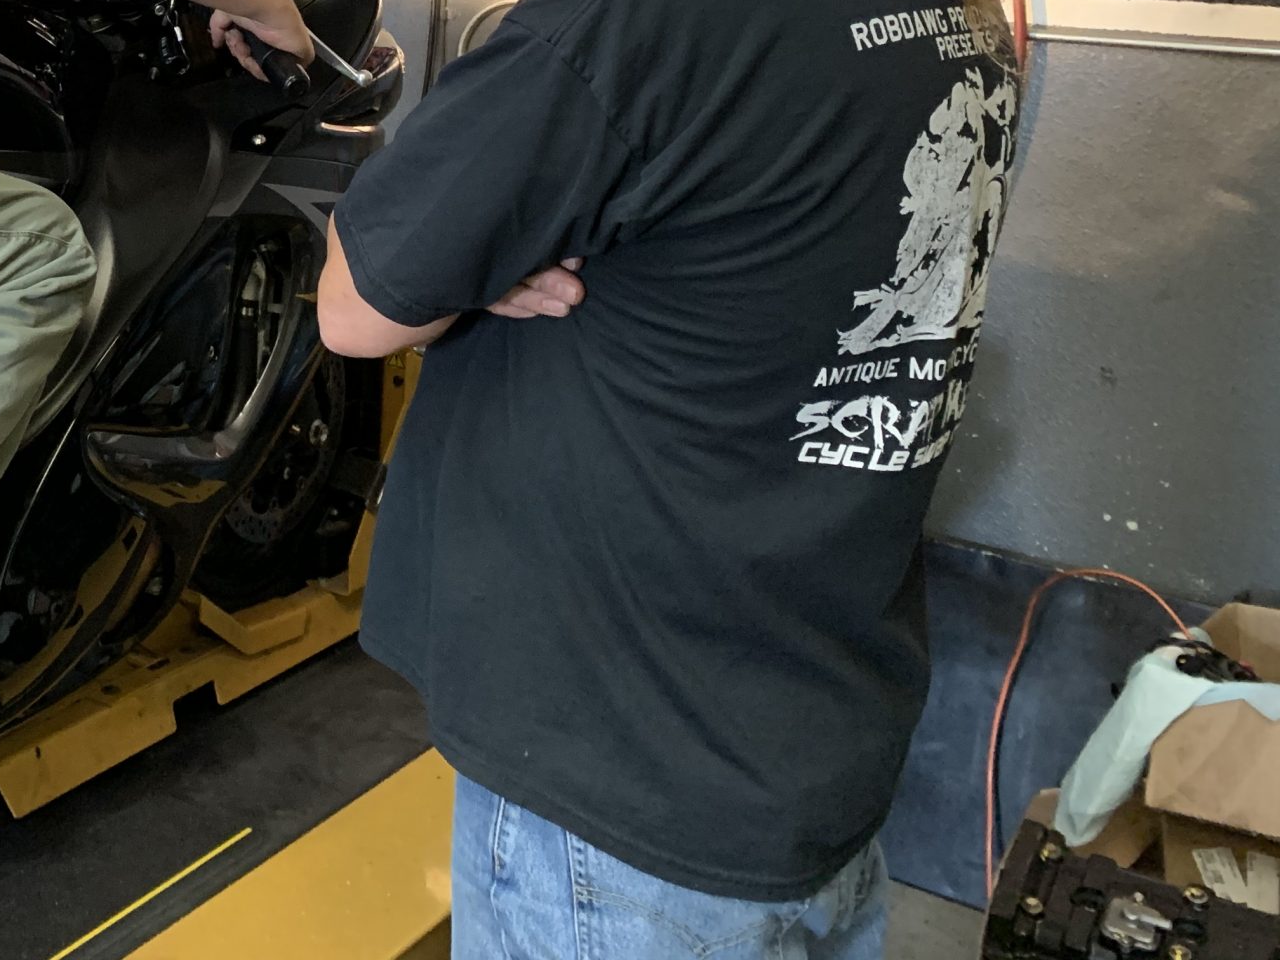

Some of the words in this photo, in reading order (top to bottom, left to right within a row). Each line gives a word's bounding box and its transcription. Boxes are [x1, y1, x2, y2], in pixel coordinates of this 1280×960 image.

[850, 8, 949, 51] ROBDAWG
[935, 30, 996, 61] PRESENTS
[813, 358, 901, 387] ANTIQUE
[798, 441, 910, 472] CYCLE
